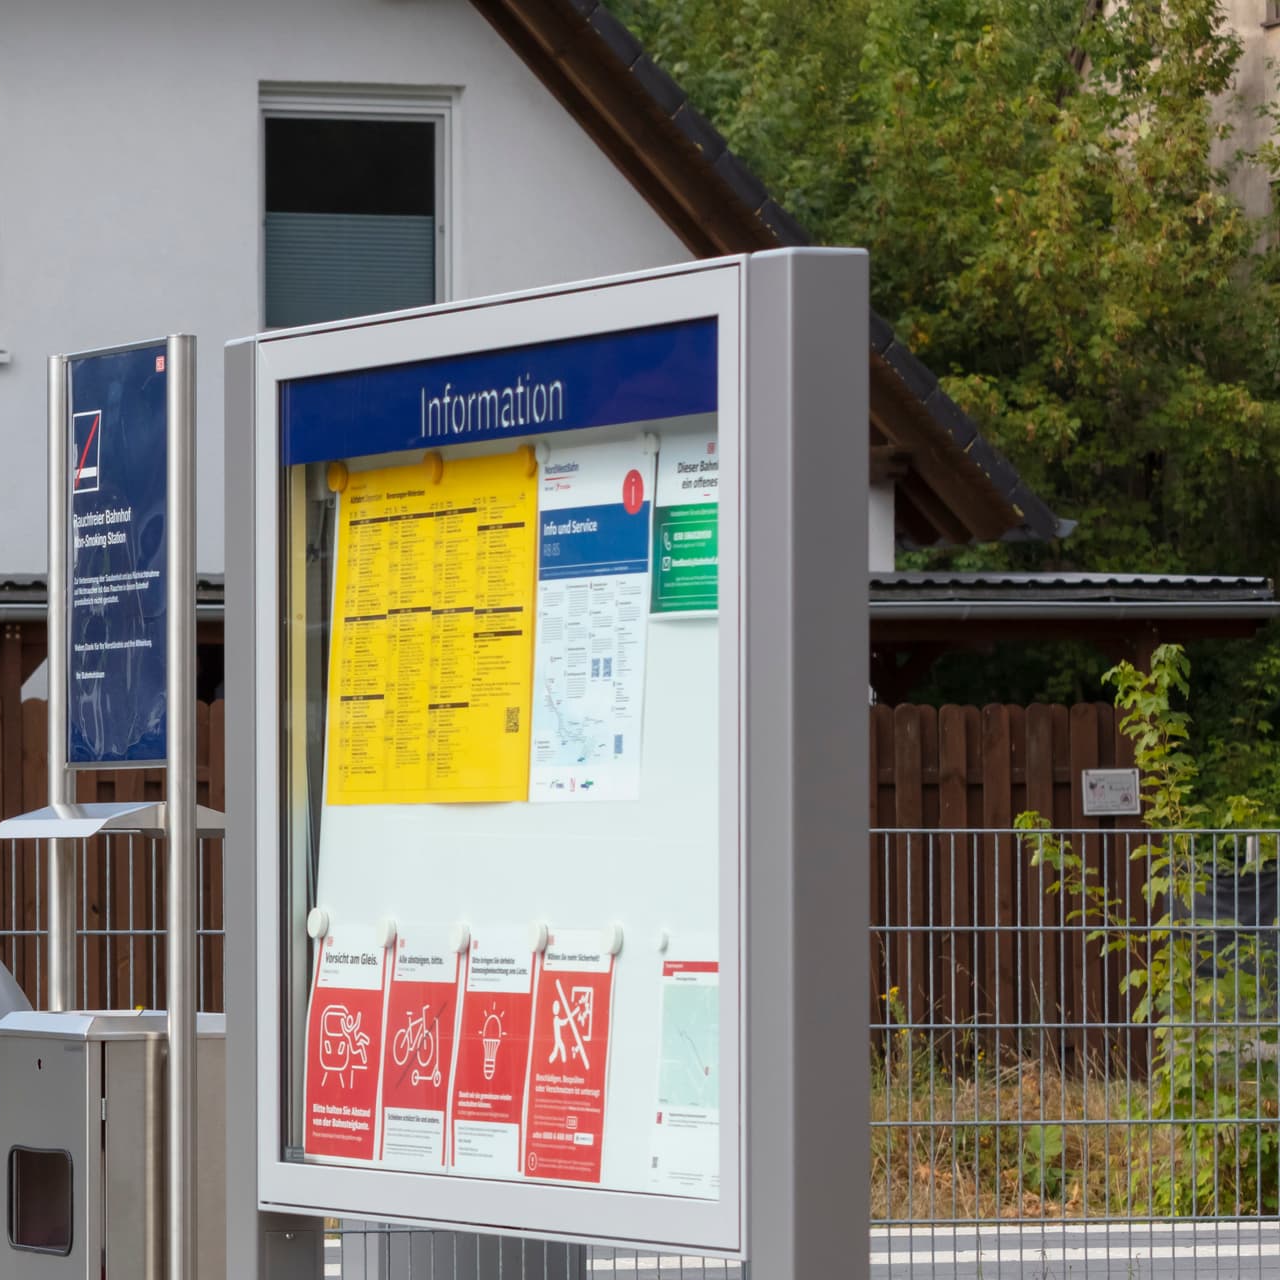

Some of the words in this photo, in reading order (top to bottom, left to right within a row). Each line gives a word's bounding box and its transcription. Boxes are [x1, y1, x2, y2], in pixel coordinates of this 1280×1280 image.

[421, 373, 563, 438] Information
[677, 461, 699, 473] Dieser
[682, 478, 693, 489] ein
[693, 476, 719, 488] offenes
[73, 511, 105, 528] Rauchfreier
[105, 506, 132, 524] Bahnhof
[543, 521, 557, 536] Info
[558, 519, 572, 535] und
[572, 518, 598, 533] Service
[74, 533, 106, 548] Non-Smoking
[107, 531, 126, 545] Station
[325, 951, 349, 965] Vorsicht
[349, 954, 360, 964] am
[360, 953, 378, 966] Gleis.
[312, 1103, 325, 1114] Bitte
[325, 1104, 342, 1115] halten
[342, 1106, 351, 1115] Sie
[351, 1106, 371, 1118] Abstand
[312, 1118, 322, 1126] von
[322, 1117, 332, 1127] der
